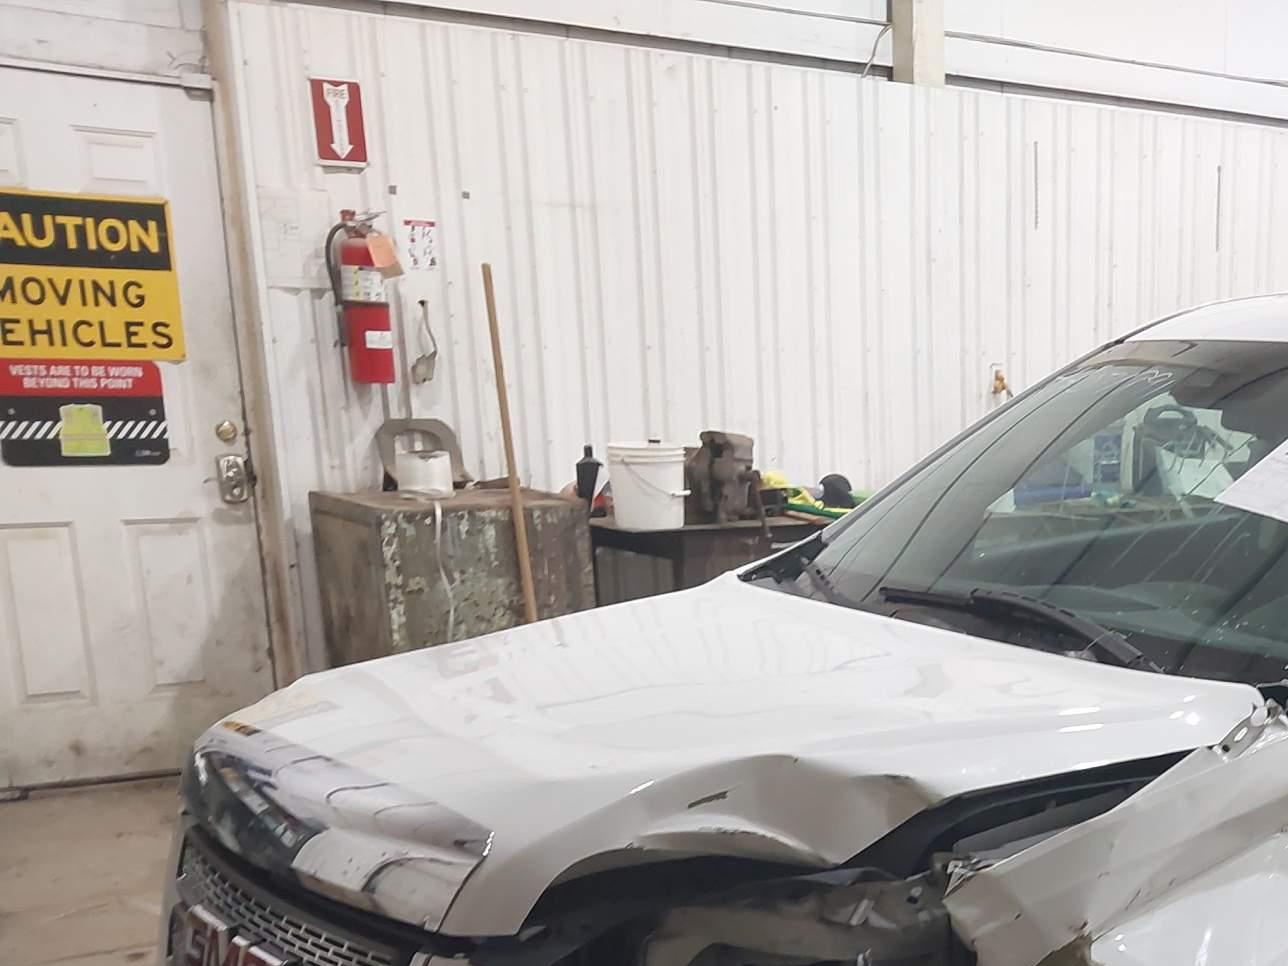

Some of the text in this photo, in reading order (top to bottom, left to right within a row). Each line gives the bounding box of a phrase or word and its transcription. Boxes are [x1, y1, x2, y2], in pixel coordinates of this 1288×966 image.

[9, 364, 143, 378] VESTS ARE TO BE WORN
[23, 377, 133, 389] BEYOND THIS POINT
